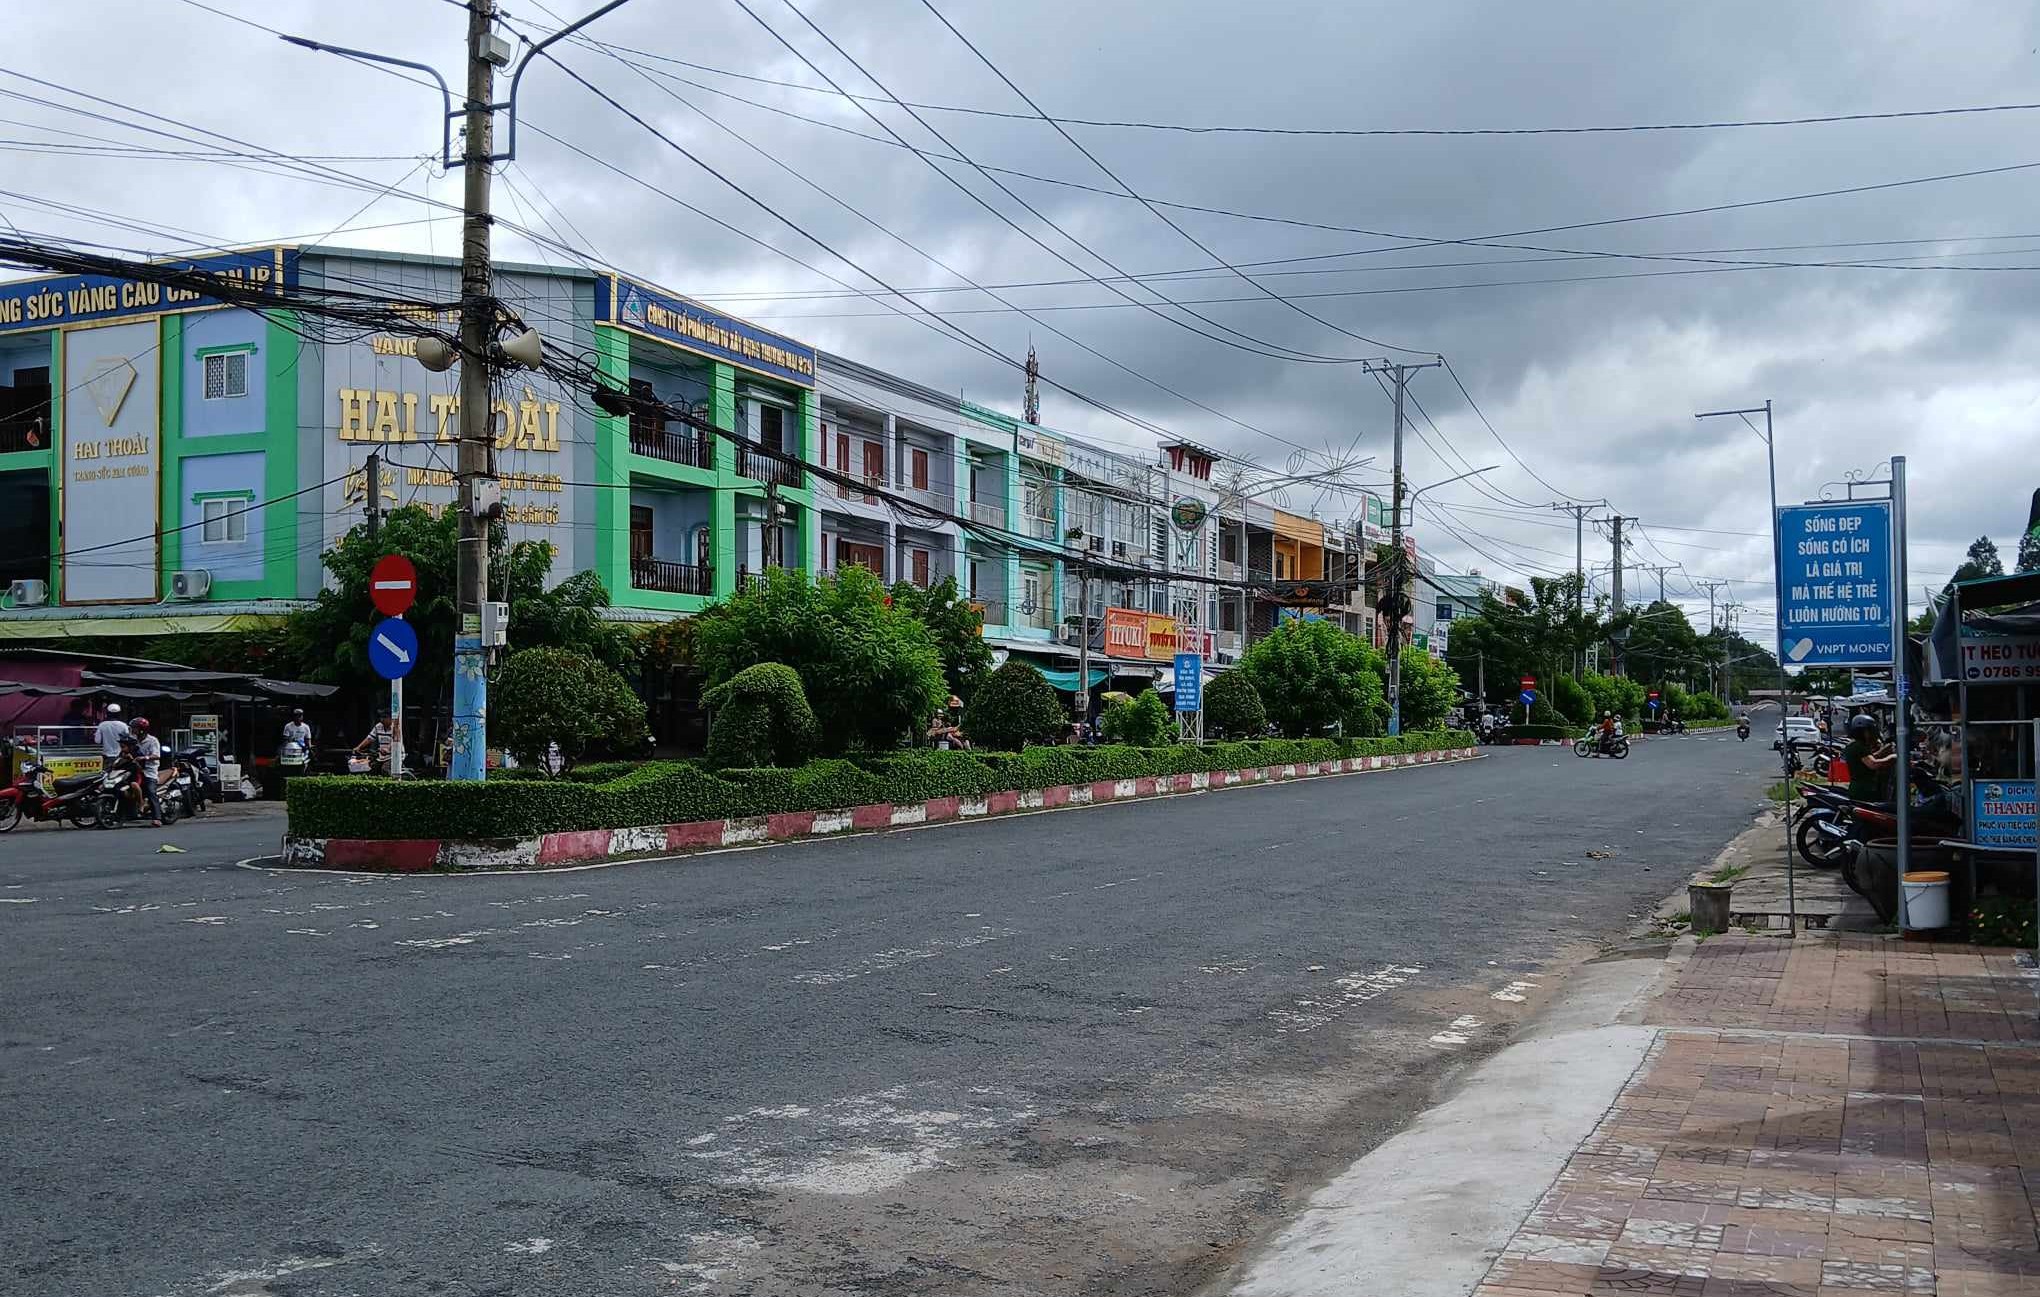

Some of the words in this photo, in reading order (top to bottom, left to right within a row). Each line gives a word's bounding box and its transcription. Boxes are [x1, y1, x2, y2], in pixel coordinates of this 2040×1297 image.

[27, 287, 63, 320] SỨC
[68, 282, 117, 314] VÀNG
[122, 281, 160, 308] CAO
[647, 302, 667, 328] CÔNG
[687, 314, 706, 341] PHẦN
[339, 388, 418, 442] HAI
[73, 441, 101, 460] HAI
[407, 468, 431, 486] MUA
[531, 474, 562, 493] TRANG
[1805, 514, 1836, 533] SỐNG
[1839, 517, 1862, 534] ĐẸP
[1798, 536, 1829, 556] SỐNG
[1832, 537, 1848, 554] CÓ
[1850, 536, 1870, 554] ÍCH
[1806, 560, 1820, 578] LÀ
[1823, 560, 1842, 577] GIÁ
[1845, 561, 1863, 579] TRỊ
[1813, 580, 1835, 600] THẾ
[1838, 581, 1853, 602] HỆ
[1856, 578, 1878, 599] TRẺ
[1789, 605, 1819, 623] LUÔN
[1822, 604, 1860, 622] HƯỚNG
[1863, 604, 1881, 621] TỚI
[1816, 644, 1846, 655] VNPT
[1849, 643, 1891, 654] MONEY
[1980, 644, 2012, 660] HEO
[1983, 665, 2021, 678] 0786
[1983, 801, 2038, 815] THANH
